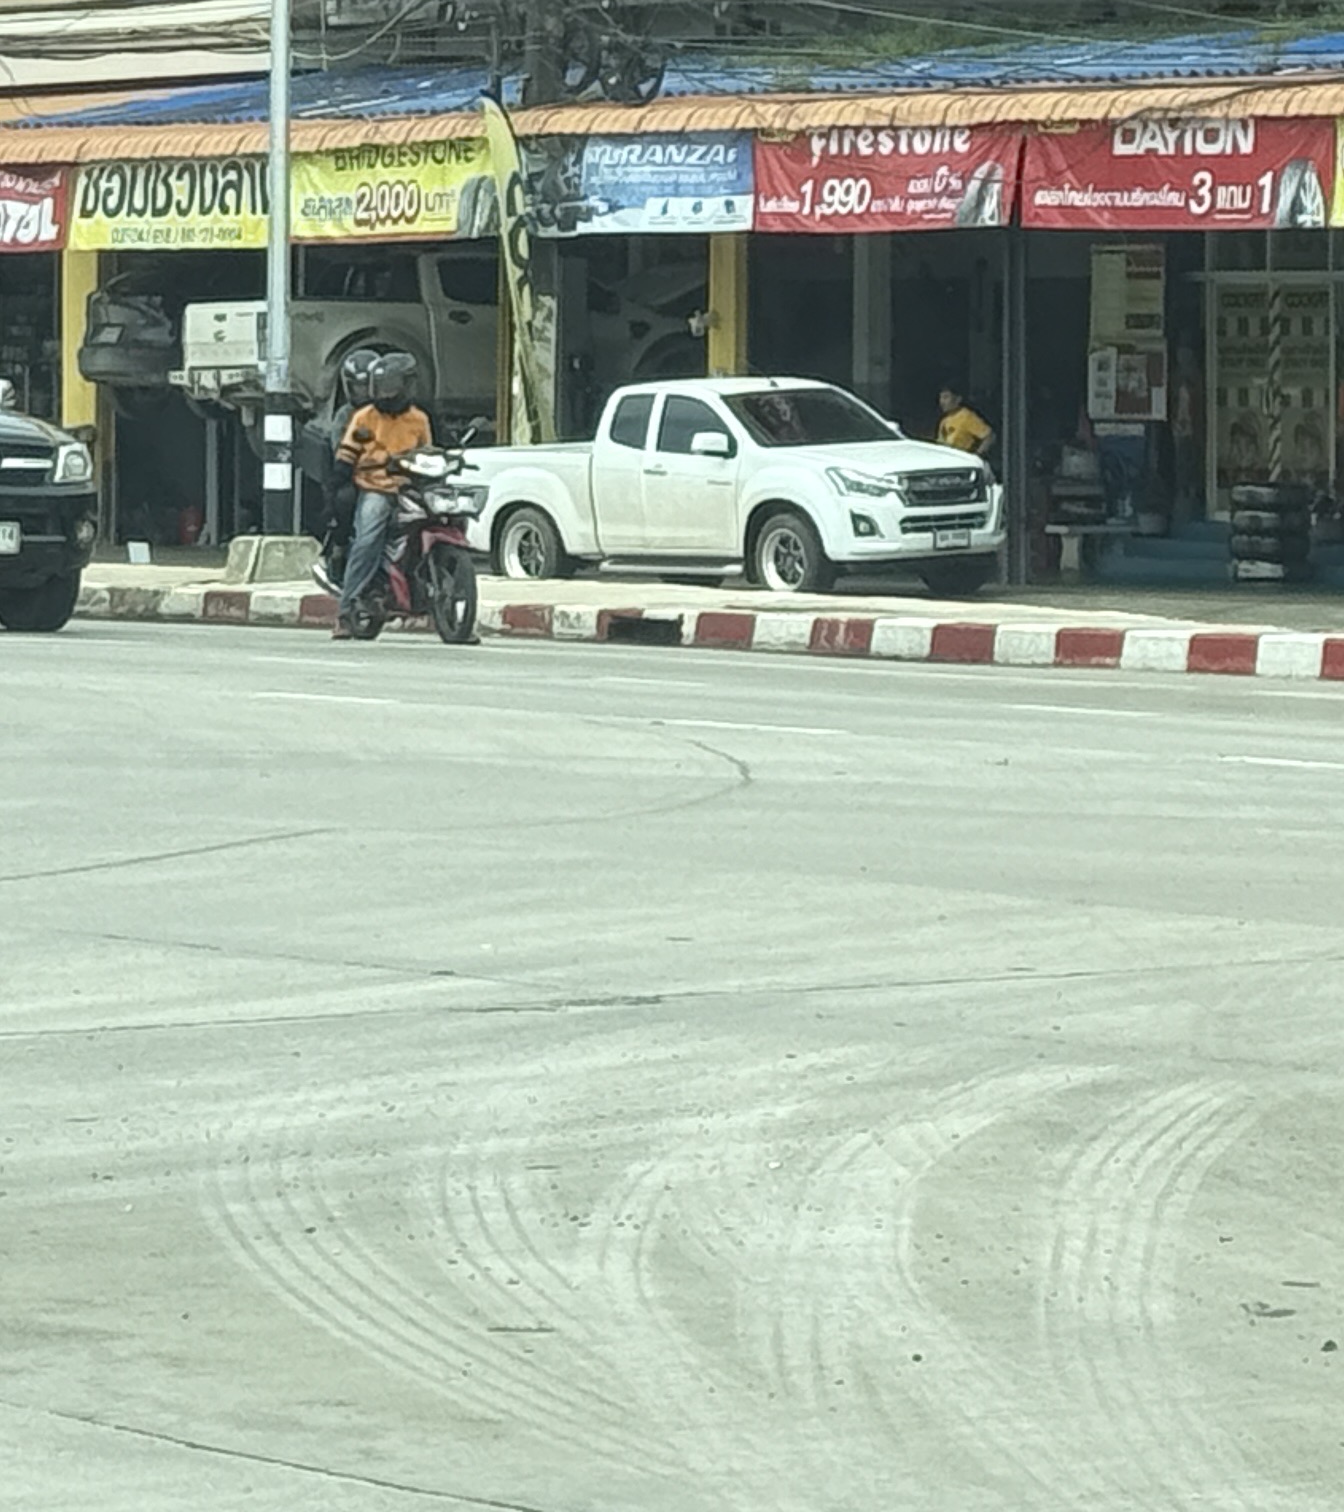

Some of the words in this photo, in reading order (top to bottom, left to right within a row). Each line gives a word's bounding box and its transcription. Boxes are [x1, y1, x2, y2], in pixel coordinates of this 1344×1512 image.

[1112, 119, 1255, 155] DAYTON
[355, 180, 421, 229] 2,000
[800, 177, 873, 221] 1,990
[1189, 171, 1212, 214] 3
[1258, 170, 1274, 214] 1
